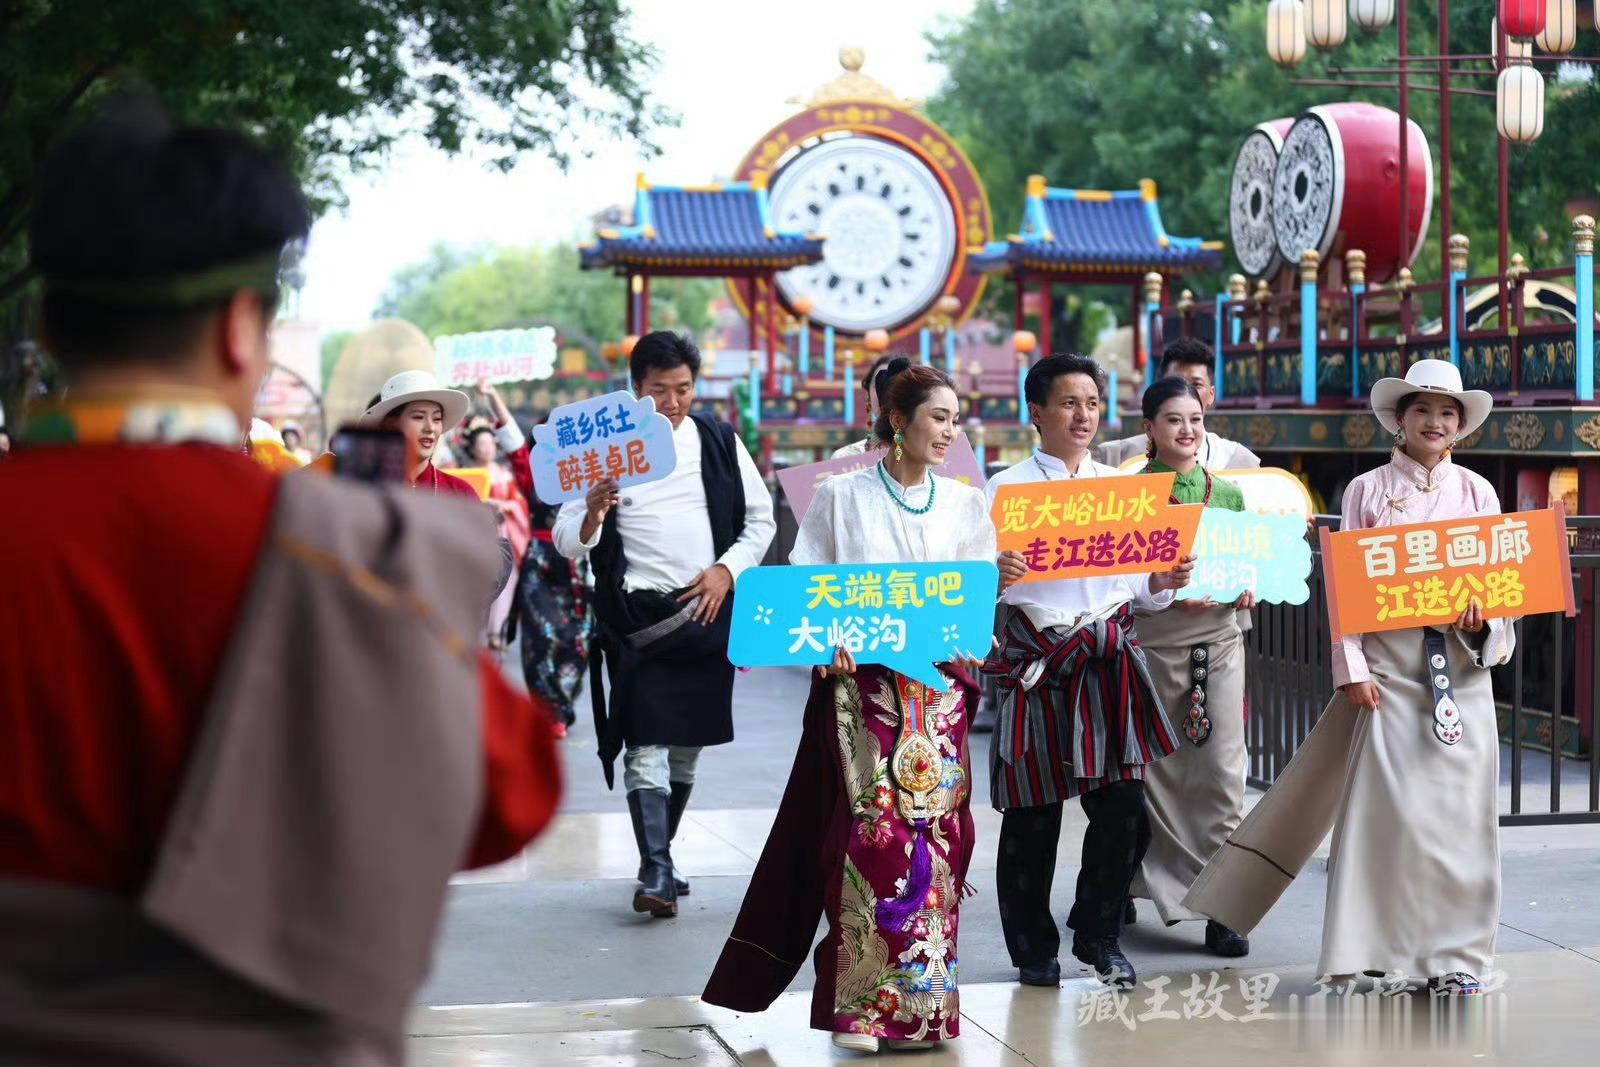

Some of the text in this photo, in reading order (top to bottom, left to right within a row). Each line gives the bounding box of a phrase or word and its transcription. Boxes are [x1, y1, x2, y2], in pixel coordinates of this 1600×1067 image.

[556, 404, 635, 448] 藏乡乐土
[557, 439, 650, 492] 醉美卓尼
[1000, 487, 1157, 533] 览大峪山水
[1022, 526, 1181, 572] 走江迭公路
[1357, 518, 1532, 579] 百里画廊
[806, 568, 964, 609] 天端氧吧
[1190, 559, 1258, 593] 峪沟
[1375, 567, 1525, 622] 江迭公路
[788, 613, 907, 654] 大峪沟
